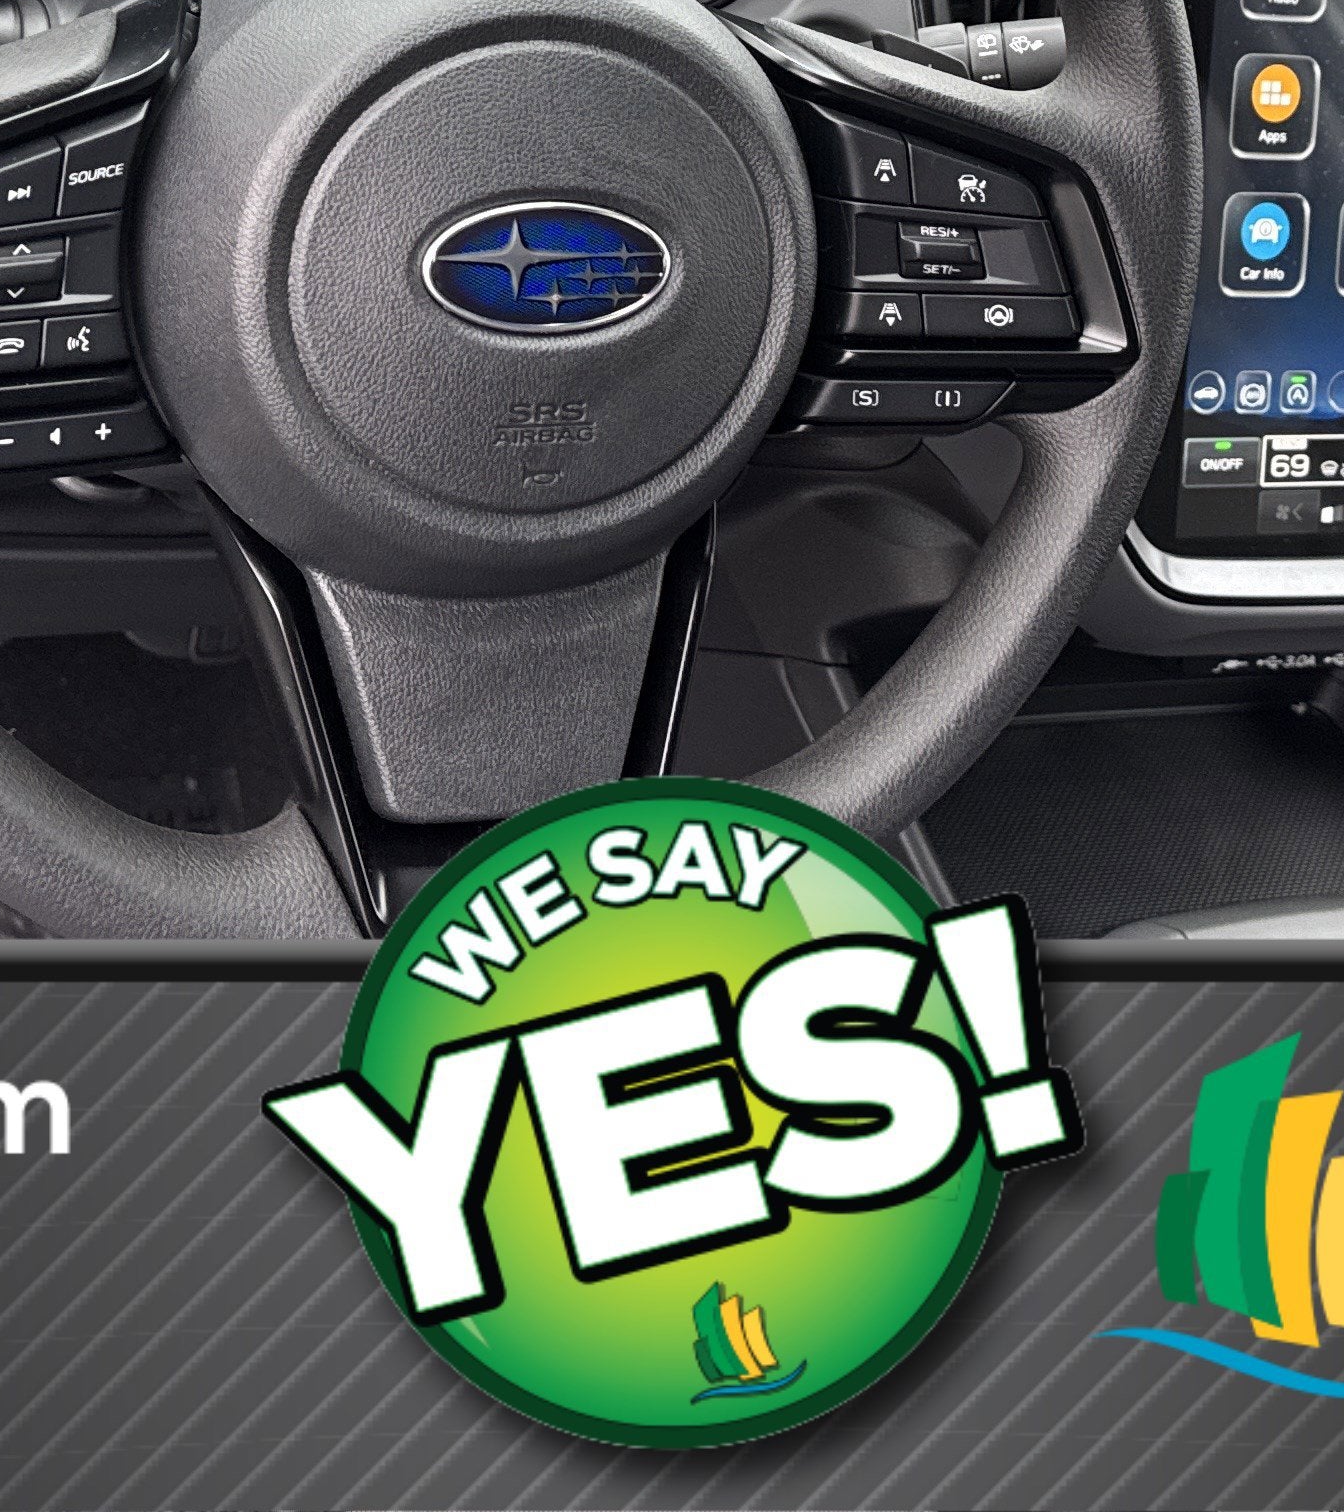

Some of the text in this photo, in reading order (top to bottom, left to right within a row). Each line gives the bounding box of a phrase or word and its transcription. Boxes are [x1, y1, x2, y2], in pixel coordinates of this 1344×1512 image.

[1258, 130, 1287, 145] Apps
[68, 162, 124, 186] SOURCE
[1240, 267, 1285, 281] Car Info
[508, 402, 588, 424] SRS
[494, 425, 596, 446] AIRBAG
[1200, 458, 1244, 473] ON/OFF
[1269, 453, 1310, 478] 69
